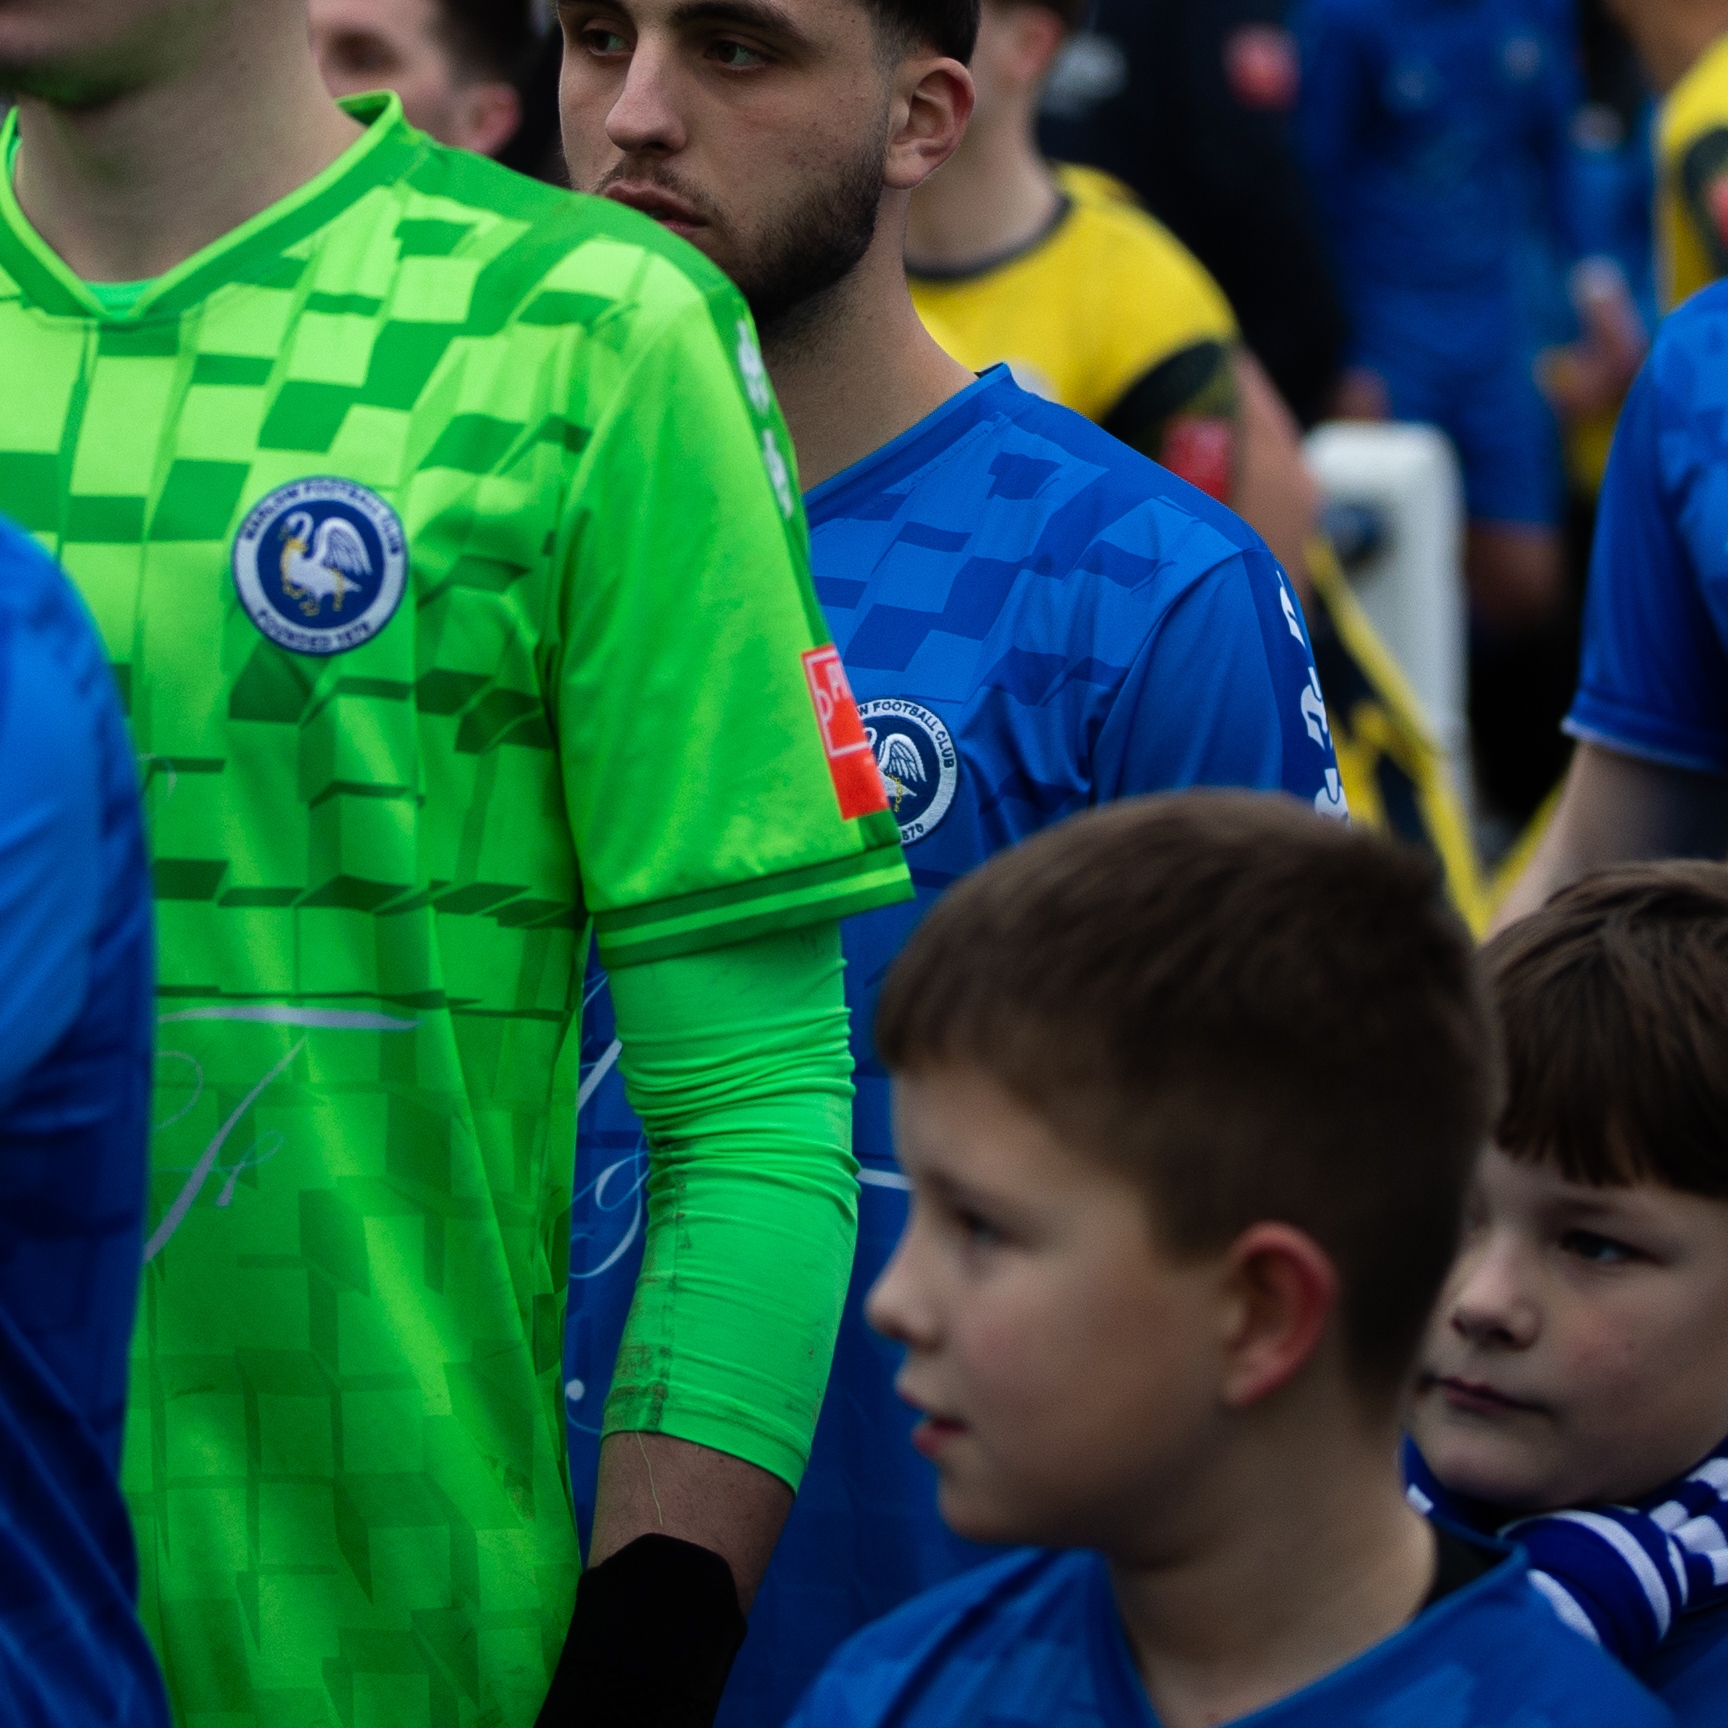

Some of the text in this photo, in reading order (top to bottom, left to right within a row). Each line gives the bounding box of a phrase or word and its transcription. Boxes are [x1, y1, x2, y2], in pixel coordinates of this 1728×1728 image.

[872, 700, 955, 769] FOOTBALL CLUB
[901, 823, 925, 842] 870
